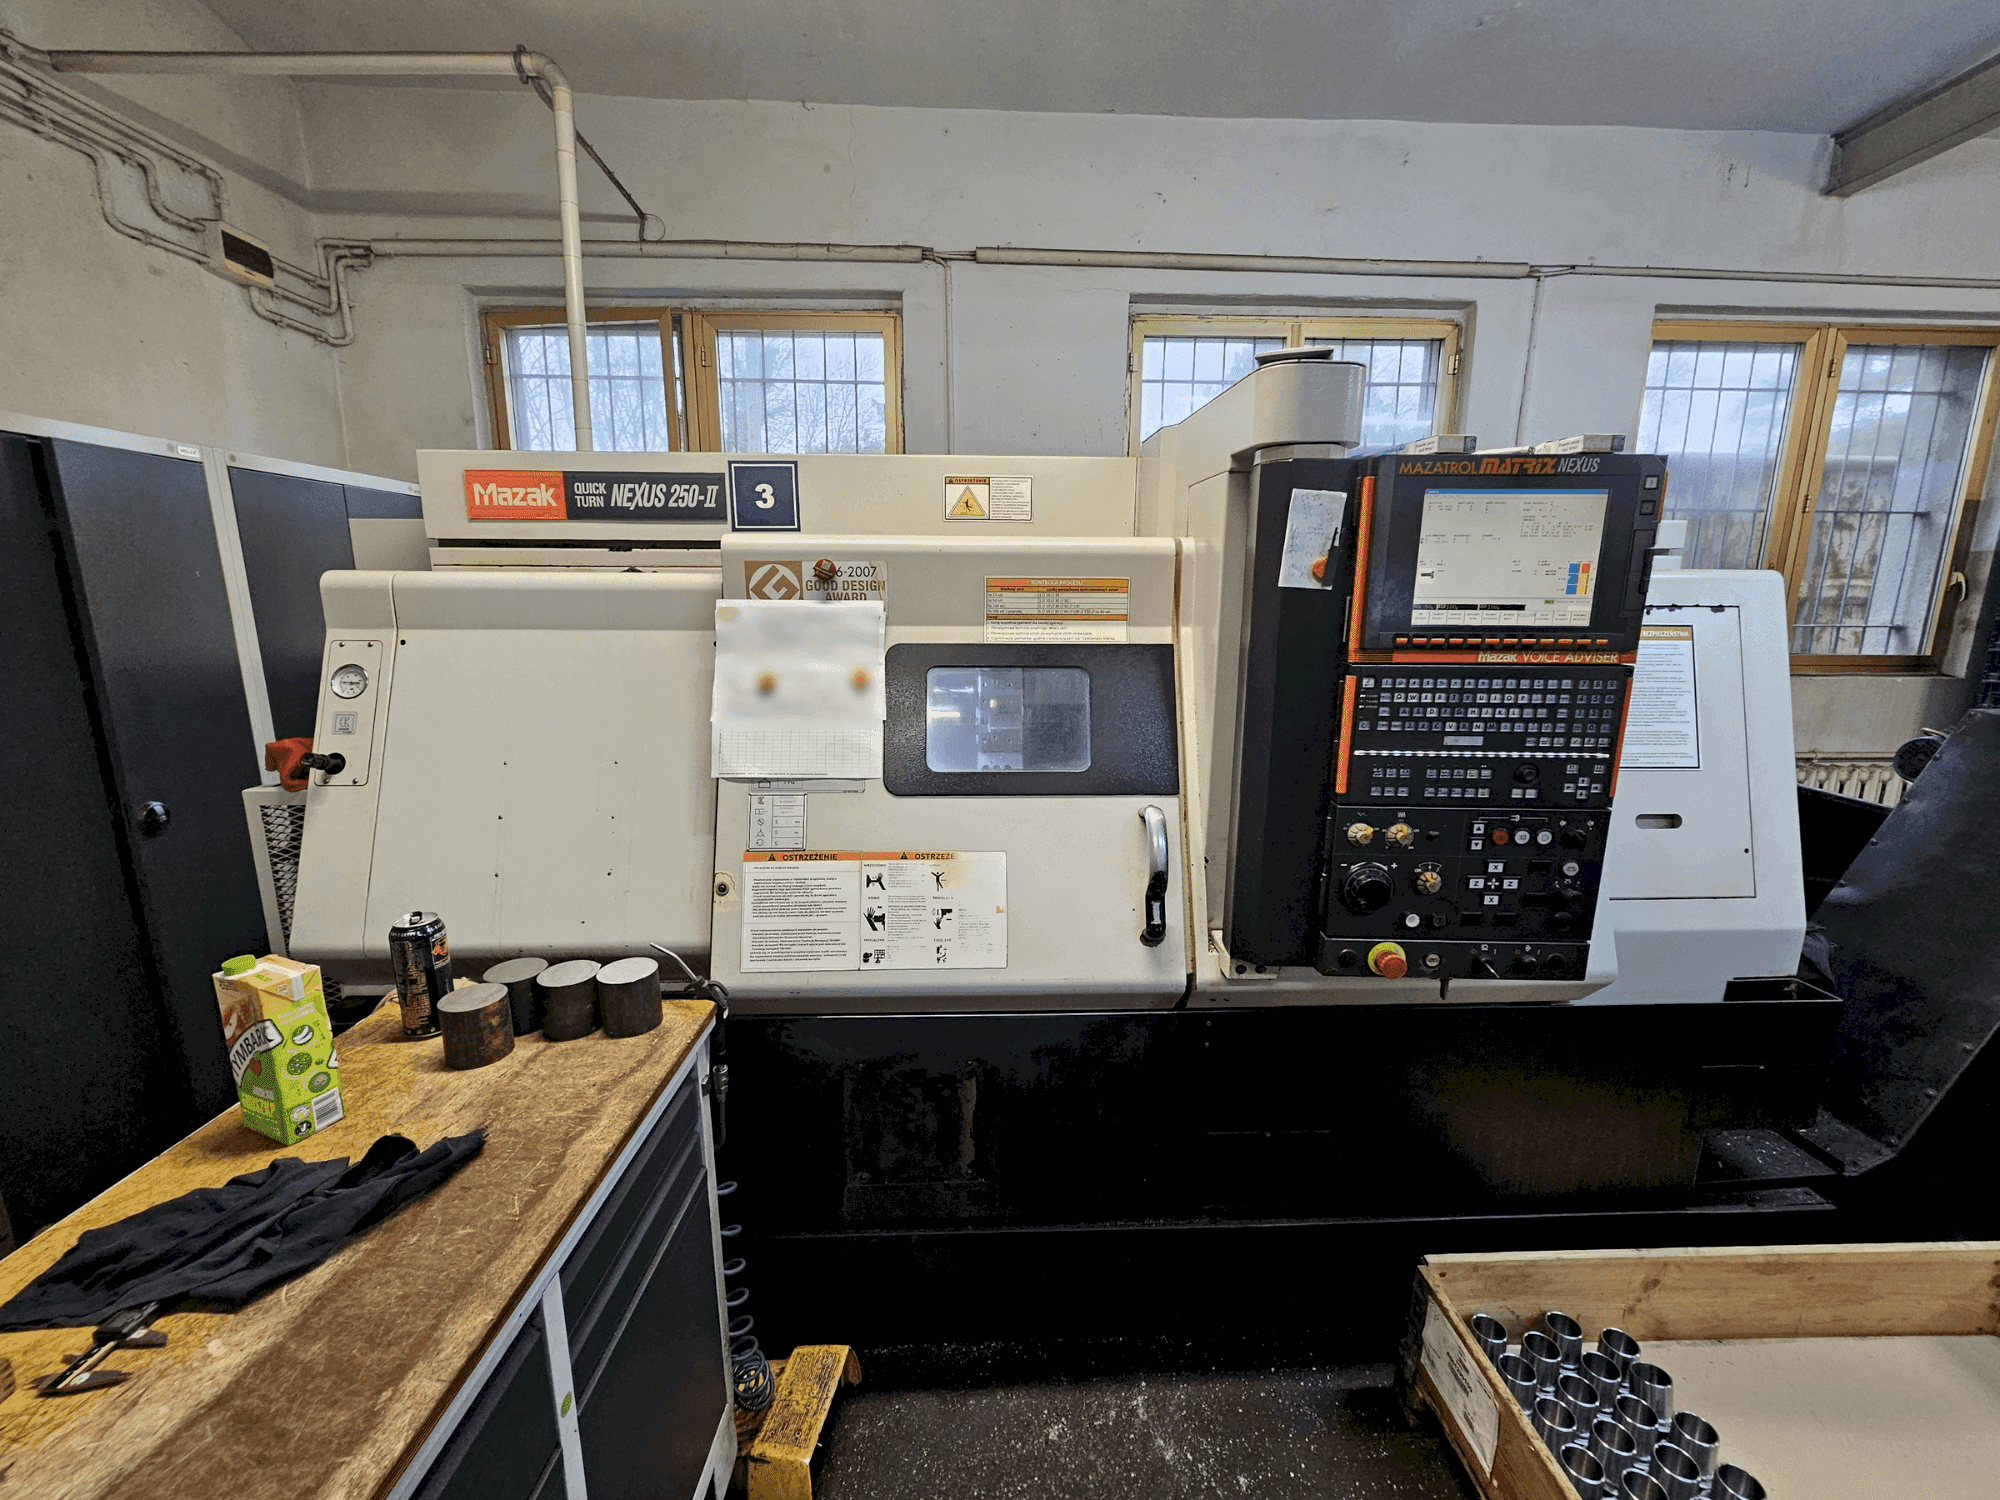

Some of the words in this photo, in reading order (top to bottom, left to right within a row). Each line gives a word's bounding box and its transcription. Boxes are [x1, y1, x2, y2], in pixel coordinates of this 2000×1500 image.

[1398, 461, 1477, 475] MAZATROL
[1479, 457, 1559, 475] MATRIX
[1557, 456, 1601, 474] NEXUS
[473, 482, 559, 508] Mazak
[574, 482, 606, 495] QUICK
[611, 481, 665, 511] NEXUS
[668, 483, 719, 508] 250-II
[575, 495, 605, 508] TURN
[754, 483, 775, 509] 3
[812, 566, 877, 578] 6-2007
[805, 580, 838, 592] GOOD
[842, 580, 886, 591] DESIGN
[825, 592, 867, 600] AWARD
[1478, 651, 1518, 663] Mazak
[1522, 652, 1560, 663] VOICE
[1563, 652, 1618, 664] ADVISER
[782, 852, 838, 861] OSTRZEŻENIE
